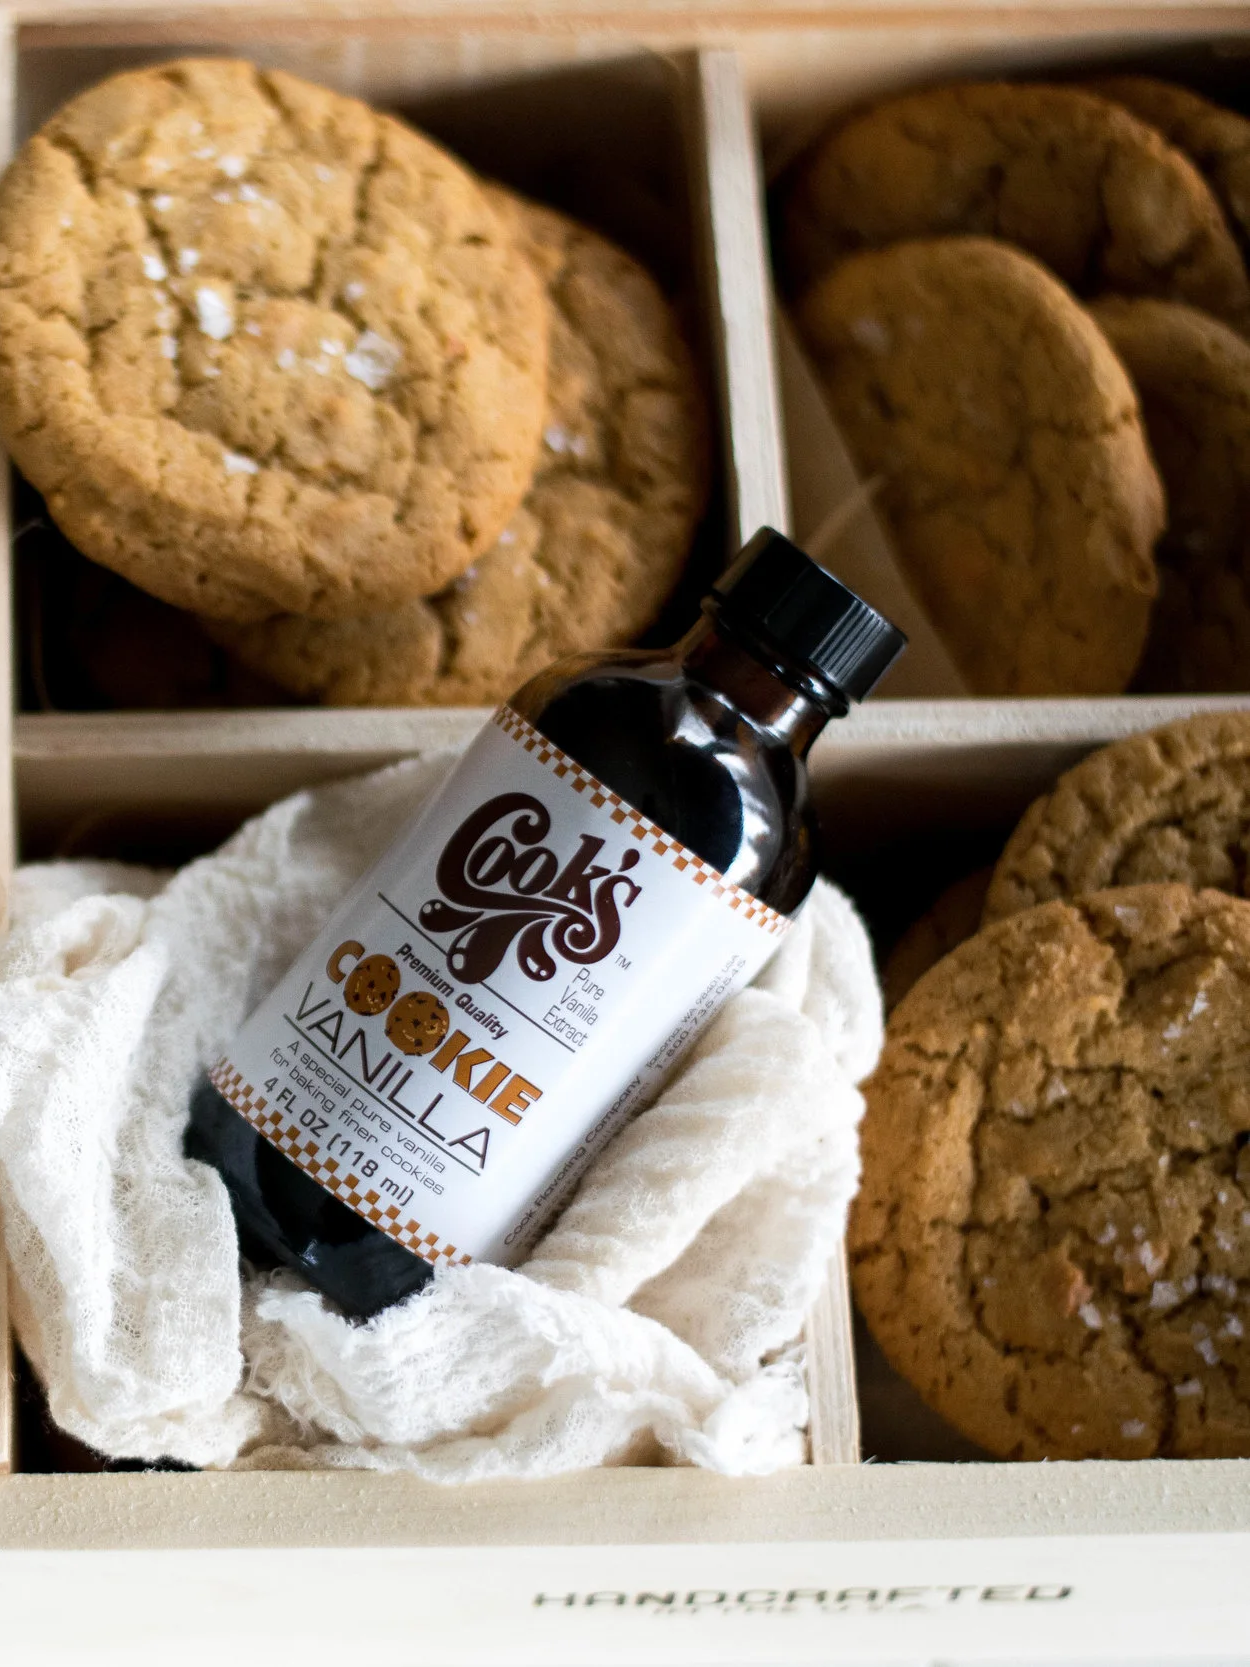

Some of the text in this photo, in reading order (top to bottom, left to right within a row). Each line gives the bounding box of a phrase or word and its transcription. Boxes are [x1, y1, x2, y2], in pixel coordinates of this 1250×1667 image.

[436, 792, 642, 965] Cook's
[326, 940, 543, 1127] COOKIE
[396, 942, 509, 1040] Premium Quality
[542, 1005, 588, 1047] Extract
[561, 985, 598, 1026] Vanilla
[572, 967, 605, 1001] Pure
[681, 1008, 697, 1023] WA
[270, 1047, 445, 1196] for baking finer cookies
[287, 1040, 446, 1174] A special pure vanilla
[295, 982, 491, 1169] VANILLA
[264, 1077, 415, 1207] 4 FL OZ (118 ml)
[504, 1075, 642, 1246] Cook Flavoring Company
[532, 1584, 1075, 1608] HANDCRAFTED
